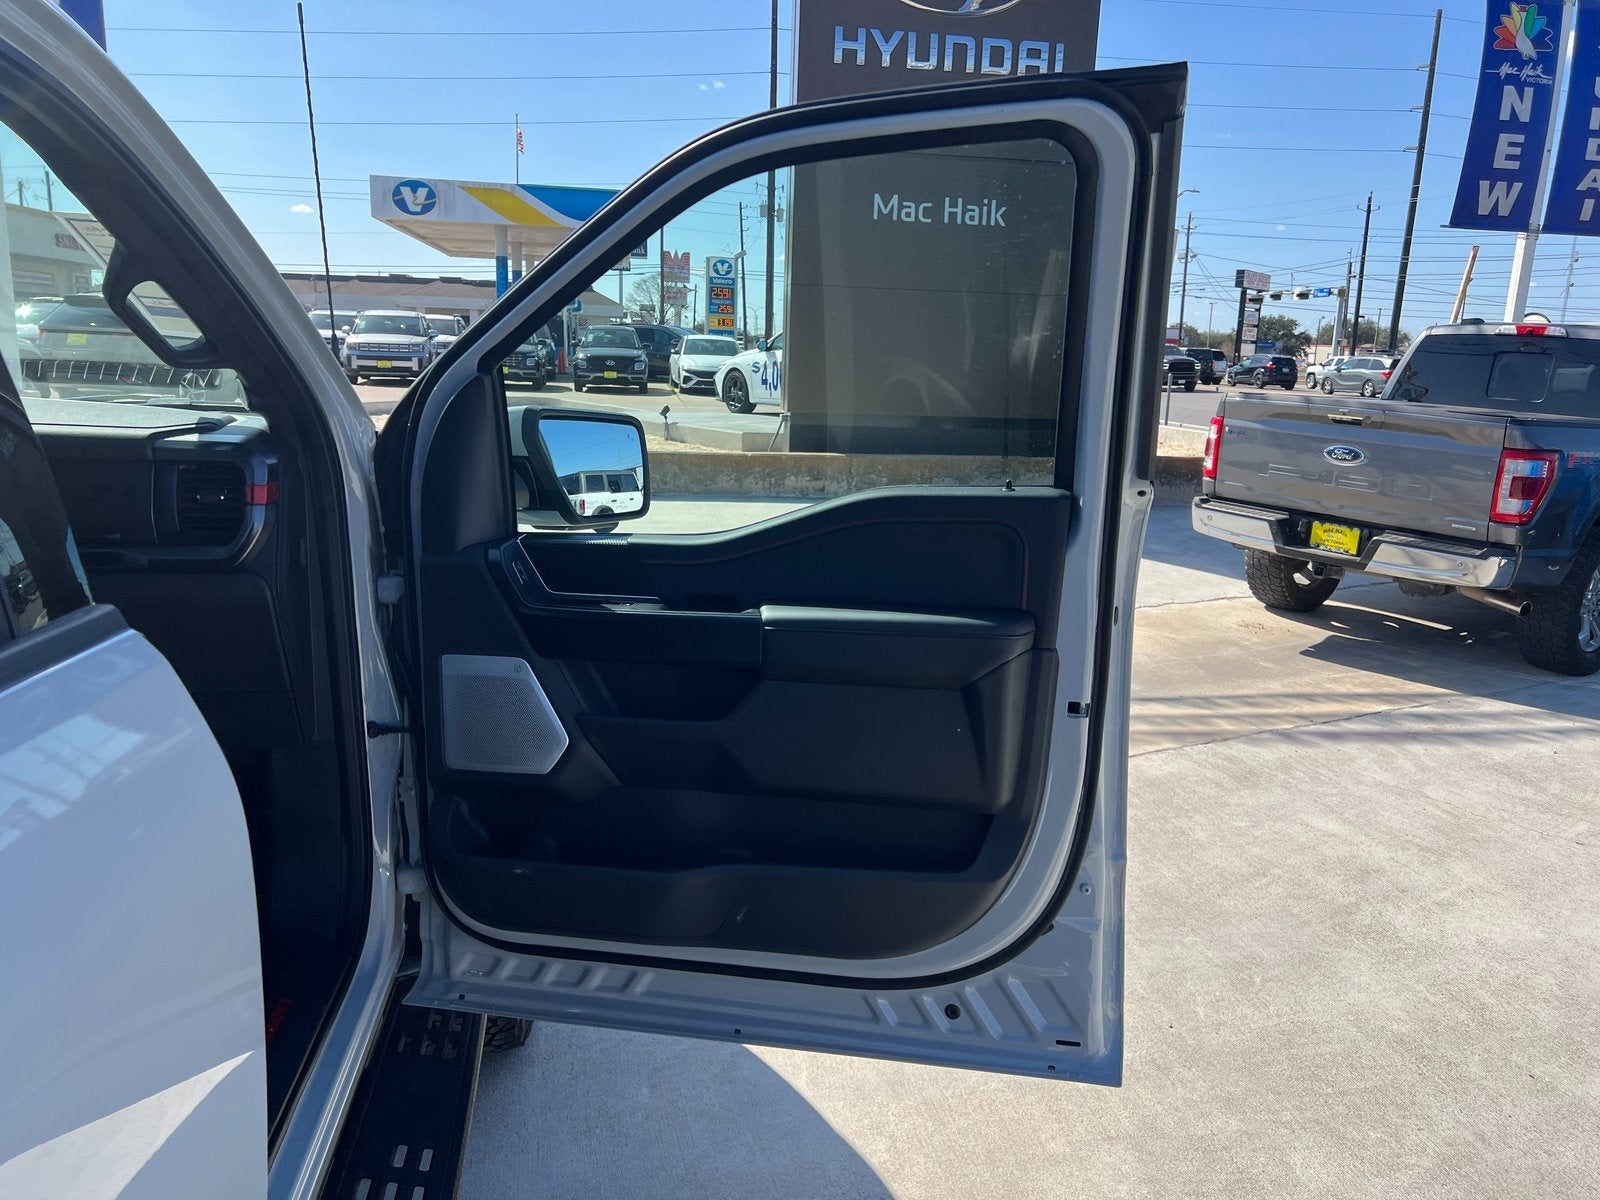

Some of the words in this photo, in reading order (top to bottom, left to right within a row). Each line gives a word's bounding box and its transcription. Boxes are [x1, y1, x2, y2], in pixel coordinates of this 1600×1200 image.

[833, 25, 1065, 76] HYUNDAI
[1477, 85, 1534, 217] NEW
[873, 193, 933, 223] Mac
[943, 197, 1007, 227] Haik
[712, 277, 733, 285] Valero
[752, 361, 782, 398] $4,0
[1331, 448, 1355, 461] Ford
